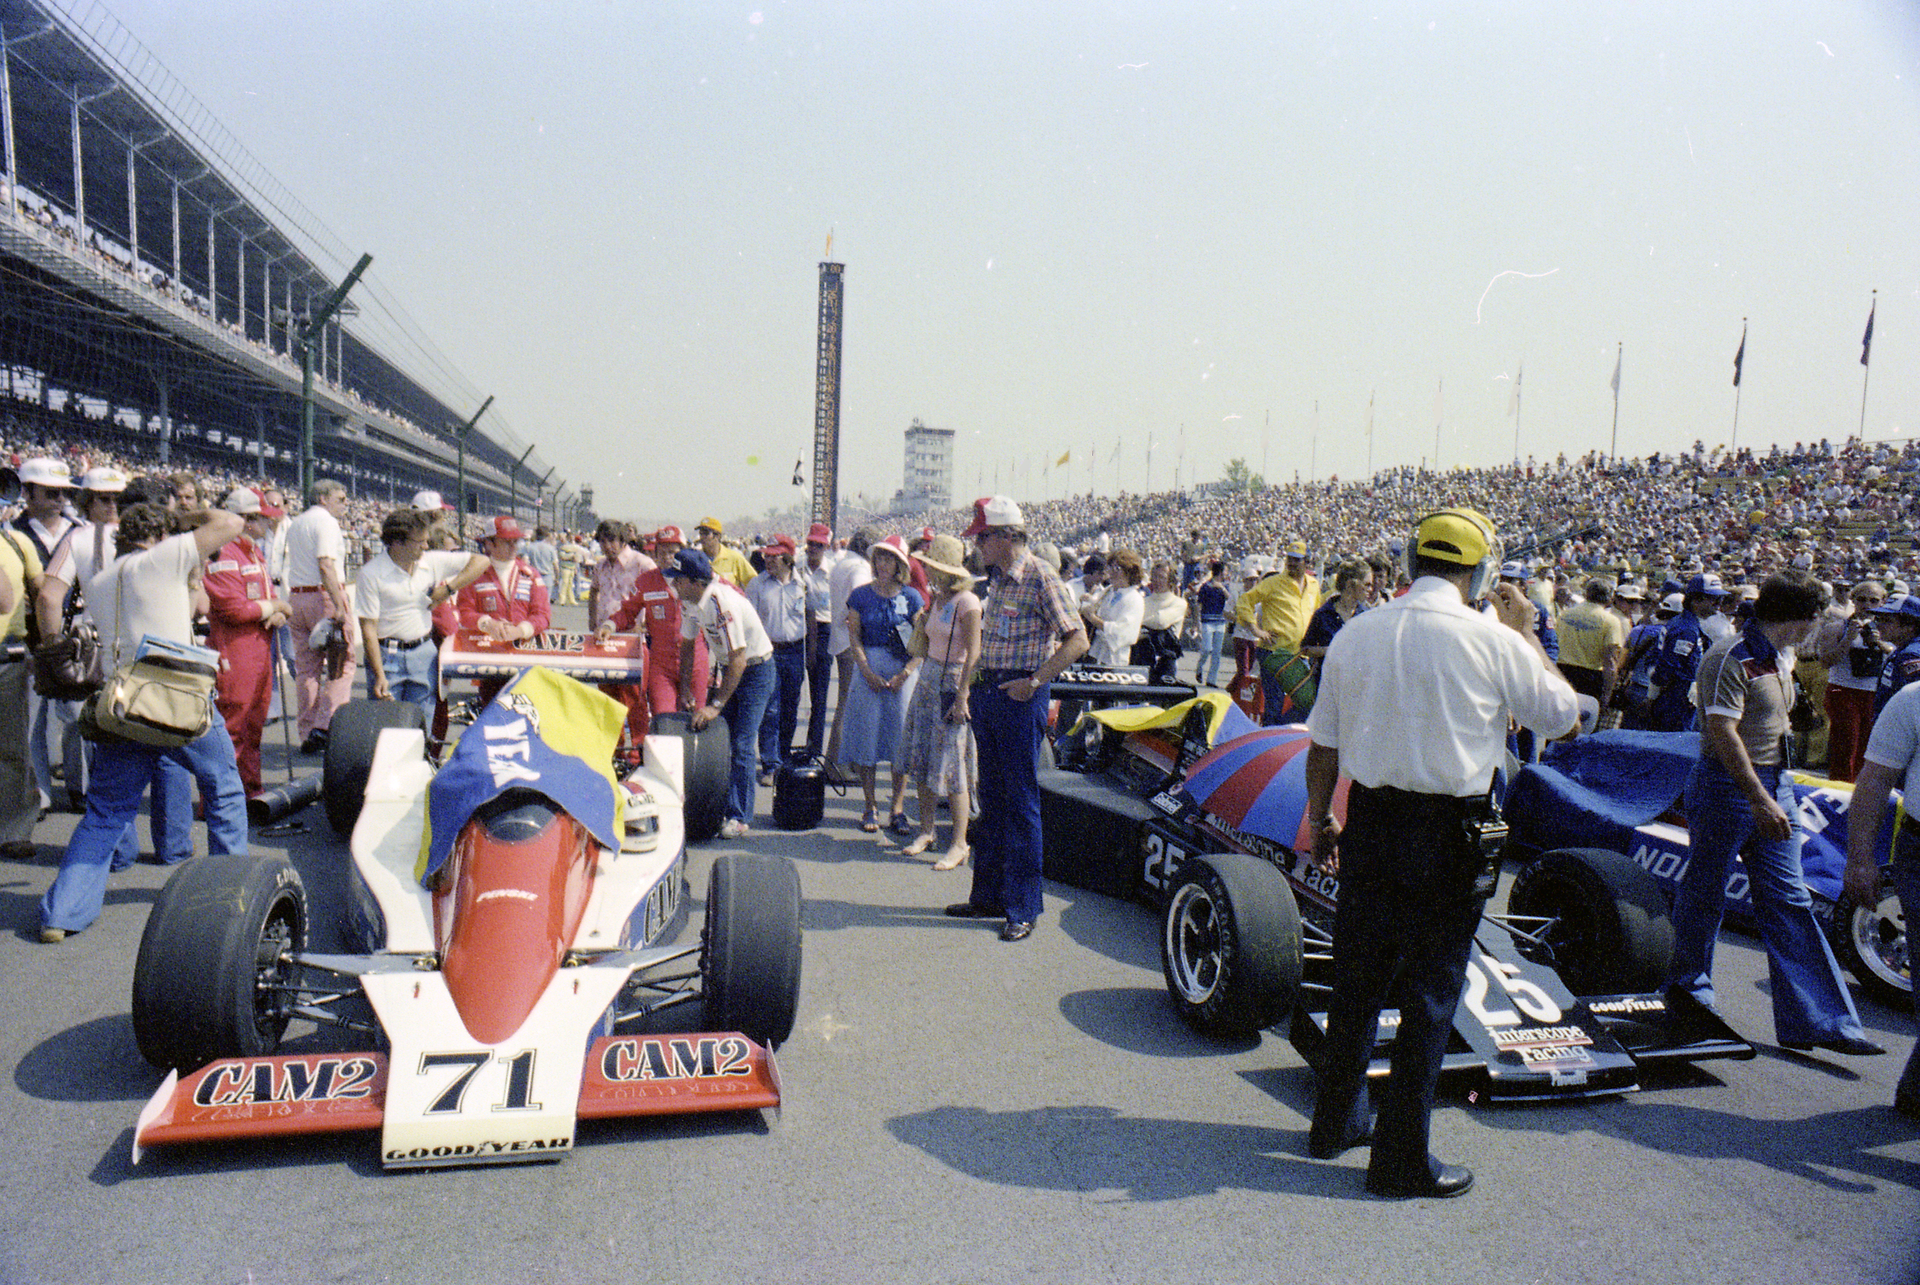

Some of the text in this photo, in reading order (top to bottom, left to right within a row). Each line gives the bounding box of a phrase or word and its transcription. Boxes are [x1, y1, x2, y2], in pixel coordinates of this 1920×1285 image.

[457, 664, 628, 679] GOOYEAR
[1059, 669, 1148, 685] rscope
[1464, 954, 1562, 1026] 25
[1588, 998, 1666, 1013] GOODYEAR
[601, 1037, 752, 1082] CAM2
[193, 1057, 378, 1107] CAM2
[416, 1048, 543, 1116] 71
[385, 1138, 570, 1160] GOODYEAR
